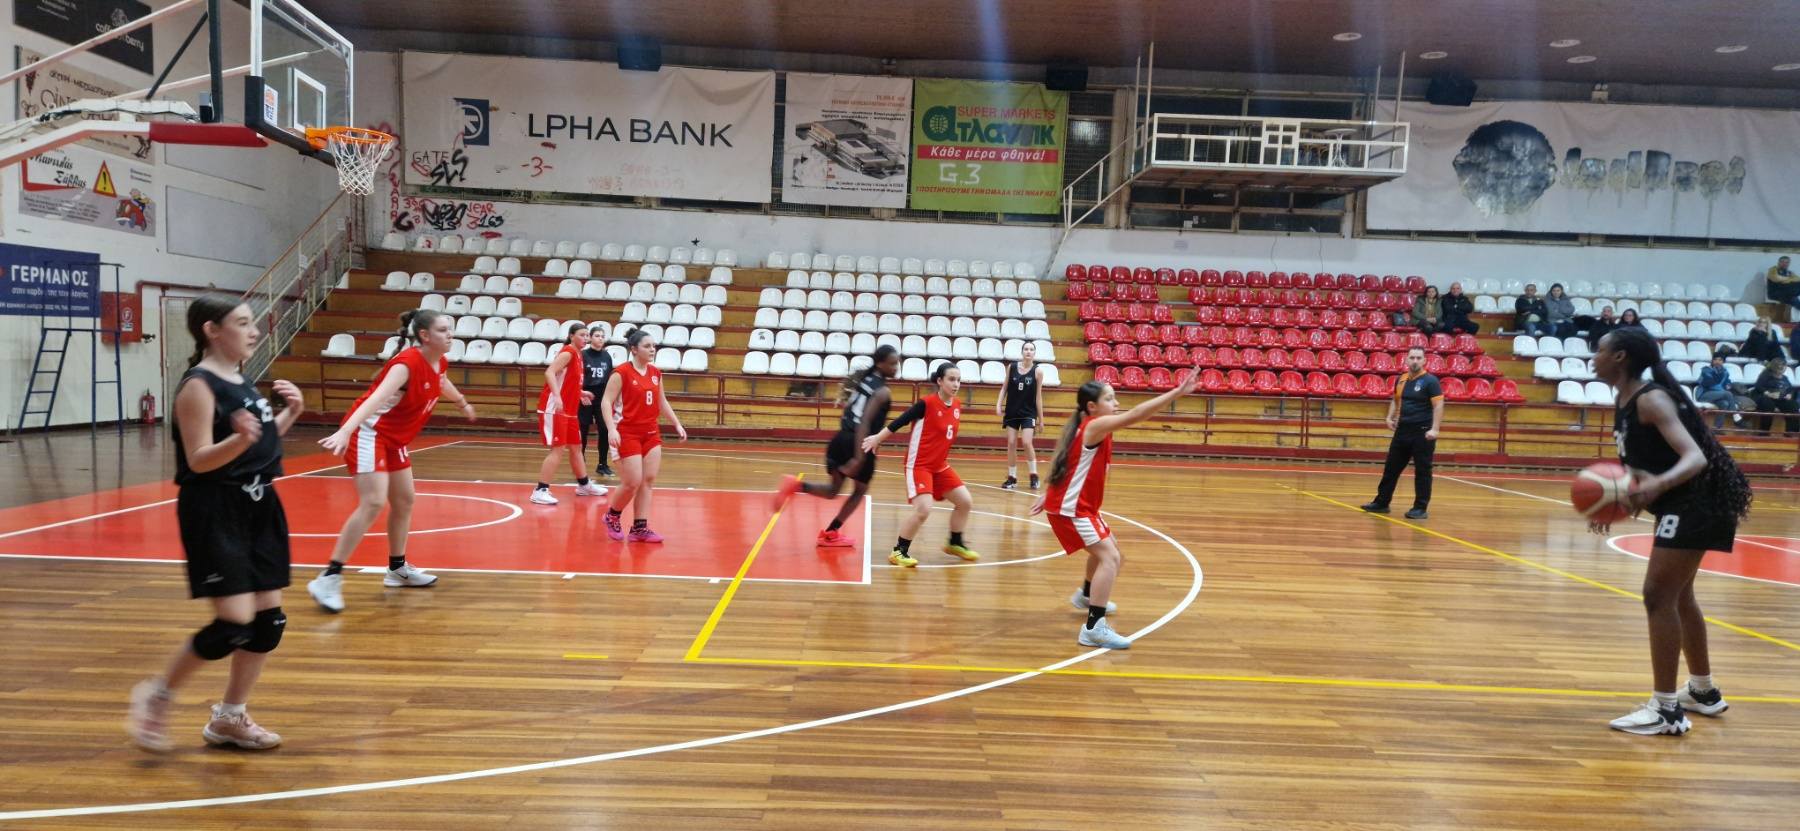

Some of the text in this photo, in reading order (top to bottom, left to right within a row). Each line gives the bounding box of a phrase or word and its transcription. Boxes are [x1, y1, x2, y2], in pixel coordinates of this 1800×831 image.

[958, 106, 1056, 120] SUPER MARKETS
[528, 113, 733, 147] LPHA BANK
[930, 146, 1045, 162] Κάθε μέρα φθηνά!
[11, 264, 89, 287] ΓΕΡΜΑΝΟΣ
[27, 287, 46, 297] καρδι
[590, 367, 604, 378] 79
[645, 390, 653, 405] 8
[1656, 514, 1680, 539] 8
